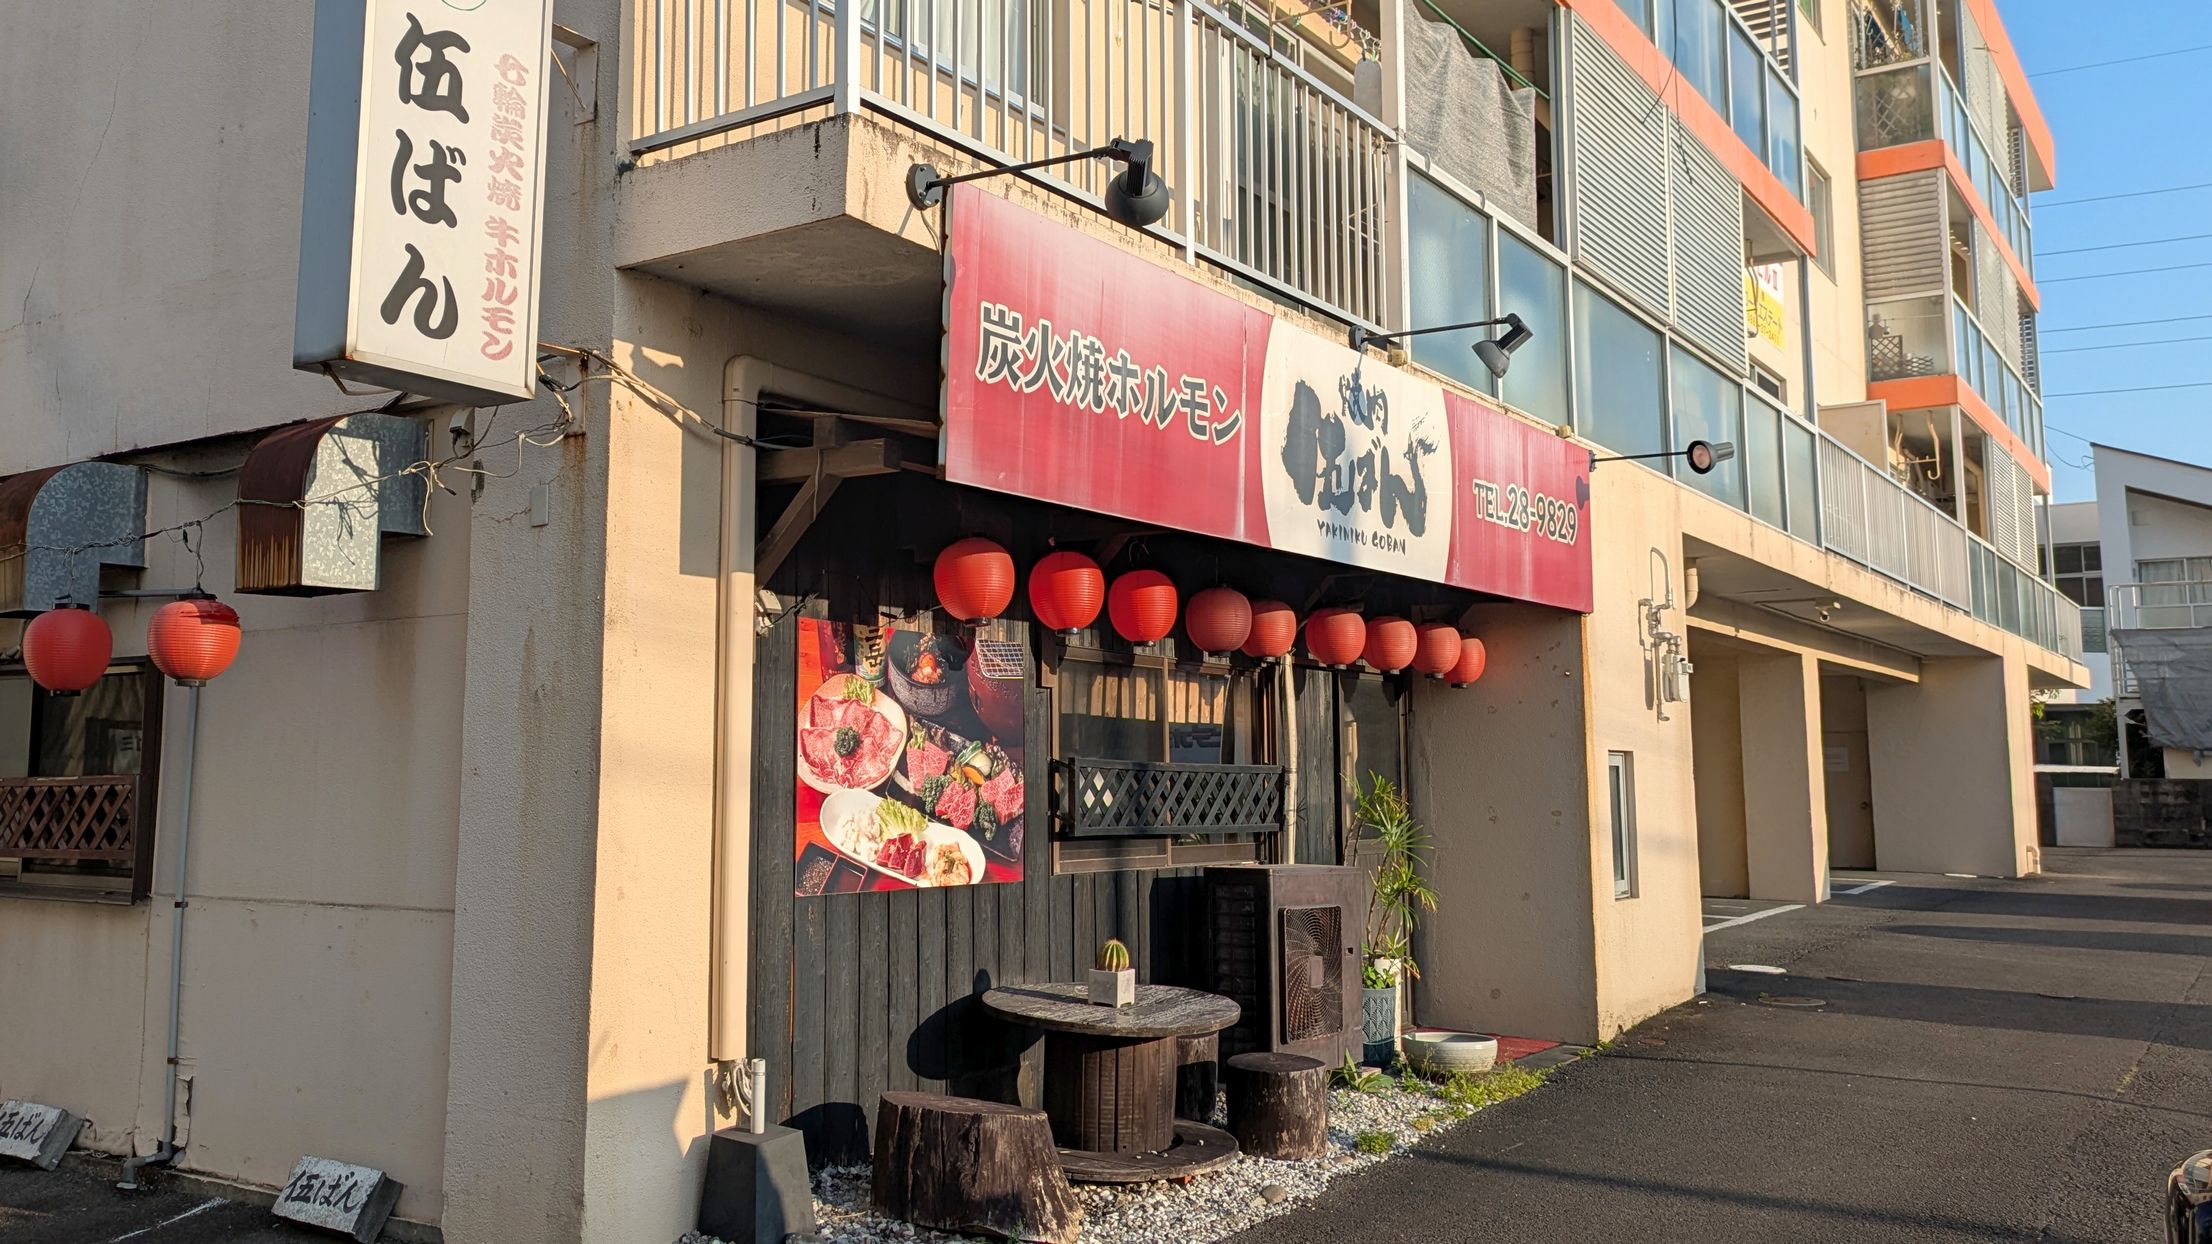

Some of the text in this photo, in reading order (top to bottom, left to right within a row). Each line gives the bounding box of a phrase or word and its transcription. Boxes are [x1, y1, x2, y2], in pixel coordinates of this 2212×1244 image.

[380, 12, 471, 340] 伍ばん
[975, 301, 1243, 445] 炭火焼ホルモン
[1280, 379, 1440, 538] 伍ばん
[1316, 519, 1406, 556] YAKINIKU GOBAN
[1472, 479, 1578, 547] TEL.28-9829
[284, 1168, 364, 1215] 伍ばん
